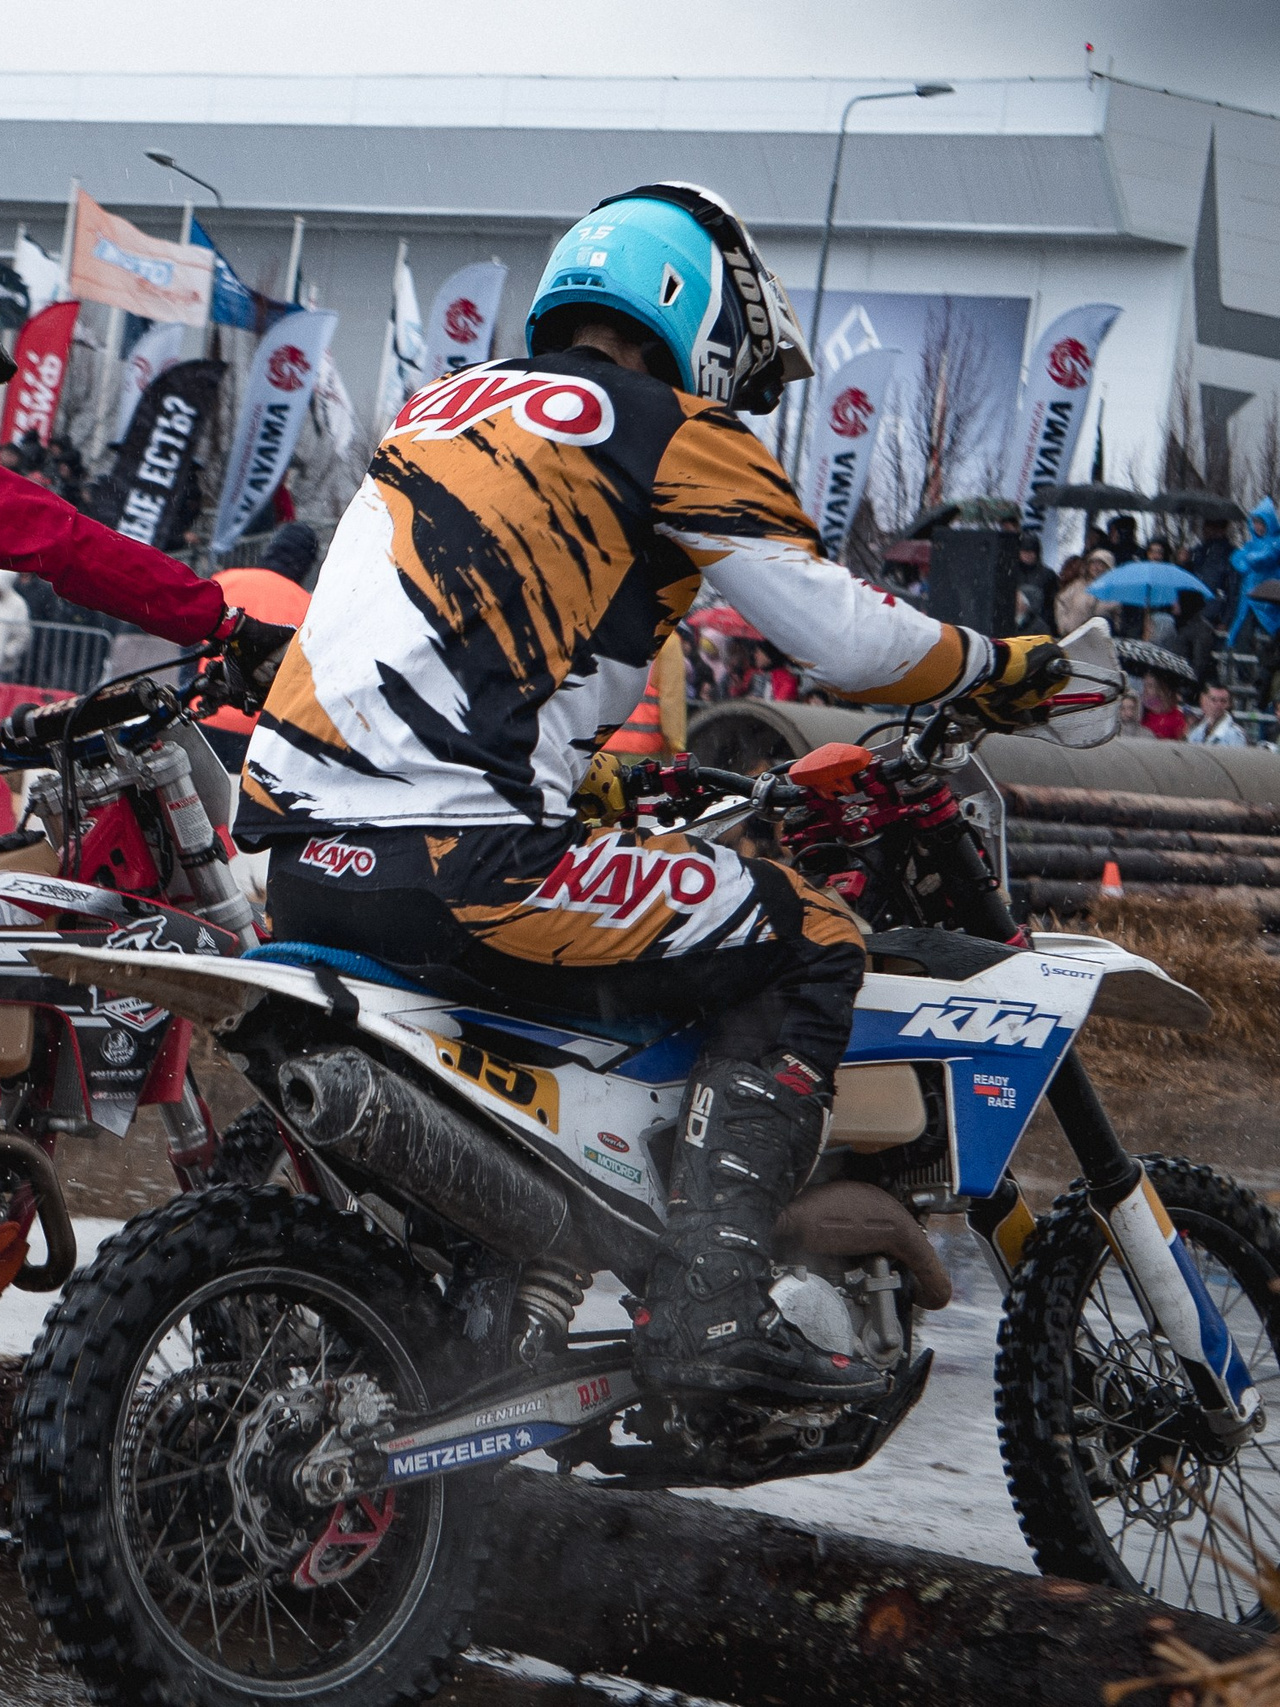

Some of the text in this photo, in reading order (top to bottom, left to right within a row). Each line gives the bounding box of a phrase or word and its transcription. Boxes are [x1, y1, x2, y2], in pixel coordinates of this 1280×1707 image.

[137, 394, 199, 489] ЕСТЬ?
[301, 835, 375, 877] KAYO
[535, 837, 718, 921] KAYO
[1052, 967, 1096, 980] SCOTT
[898, 998, 1058, 1049] KTM
[973, 1073, 1010, 1087] READY
[1001, 1087, 1016, 1098] TO
[987, 1097, 1016, 1109] RACE
[597, 1154, 641, 1182] MOTOREX
[475, 1399, 545, 1427] RENTHAL
[393, 1433, 511, 1475] METZELER
